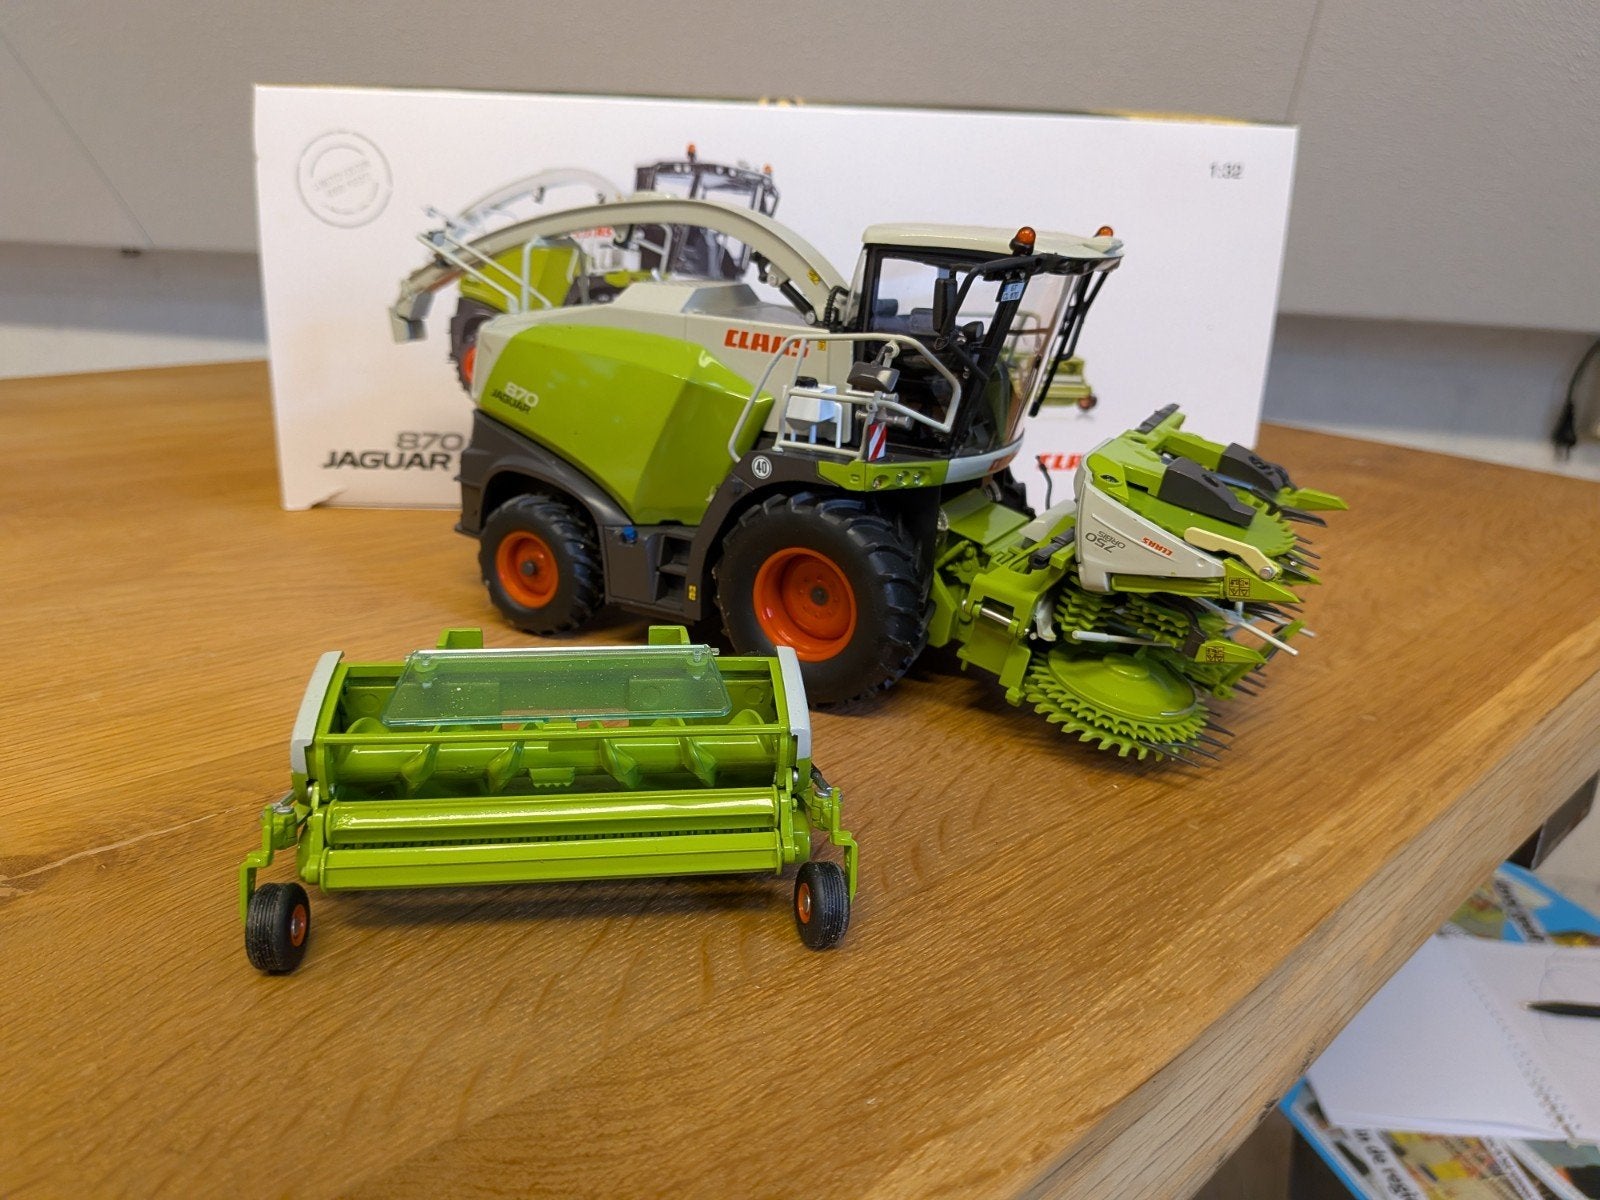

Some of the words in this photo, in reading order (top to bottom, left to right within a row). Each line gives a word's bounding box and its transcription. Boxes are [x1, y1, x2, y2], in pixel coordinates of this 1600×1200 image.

[491, 389, 532, 414] JAGUAR
[505, 381, 539, 407] 870
[396, 432, 464, 450] 870
[322, 450, 451, 470] JAGUAR
[756, 460, 768, 474] 40
[1085, 532, 1116, 553] 750
[1142, 536, 1173, 556] CLAAS
